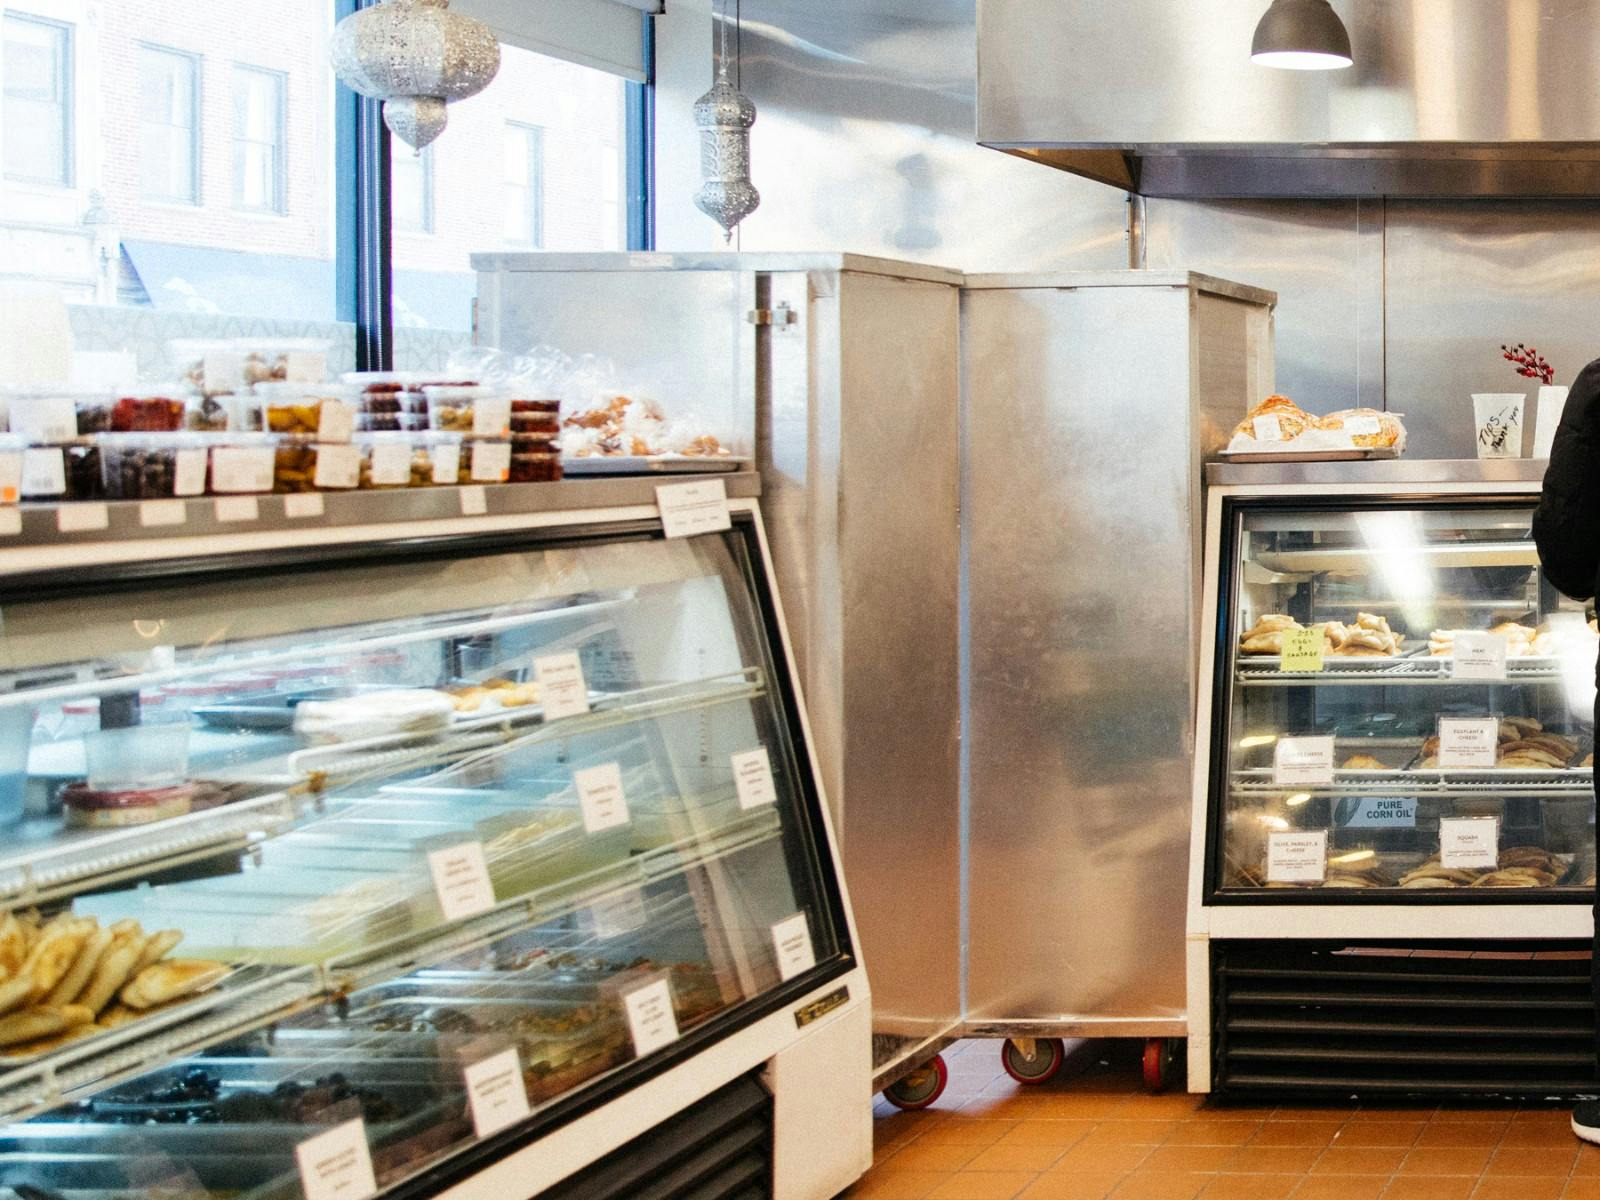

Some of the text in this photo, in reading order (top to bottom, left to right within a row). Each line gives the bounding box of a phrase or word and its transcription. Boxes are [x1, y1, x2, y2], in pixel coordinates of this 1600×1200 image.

[1377, 800, 1403, 809] PURE
[1366, 809, 1412, 819] CORN OIL
